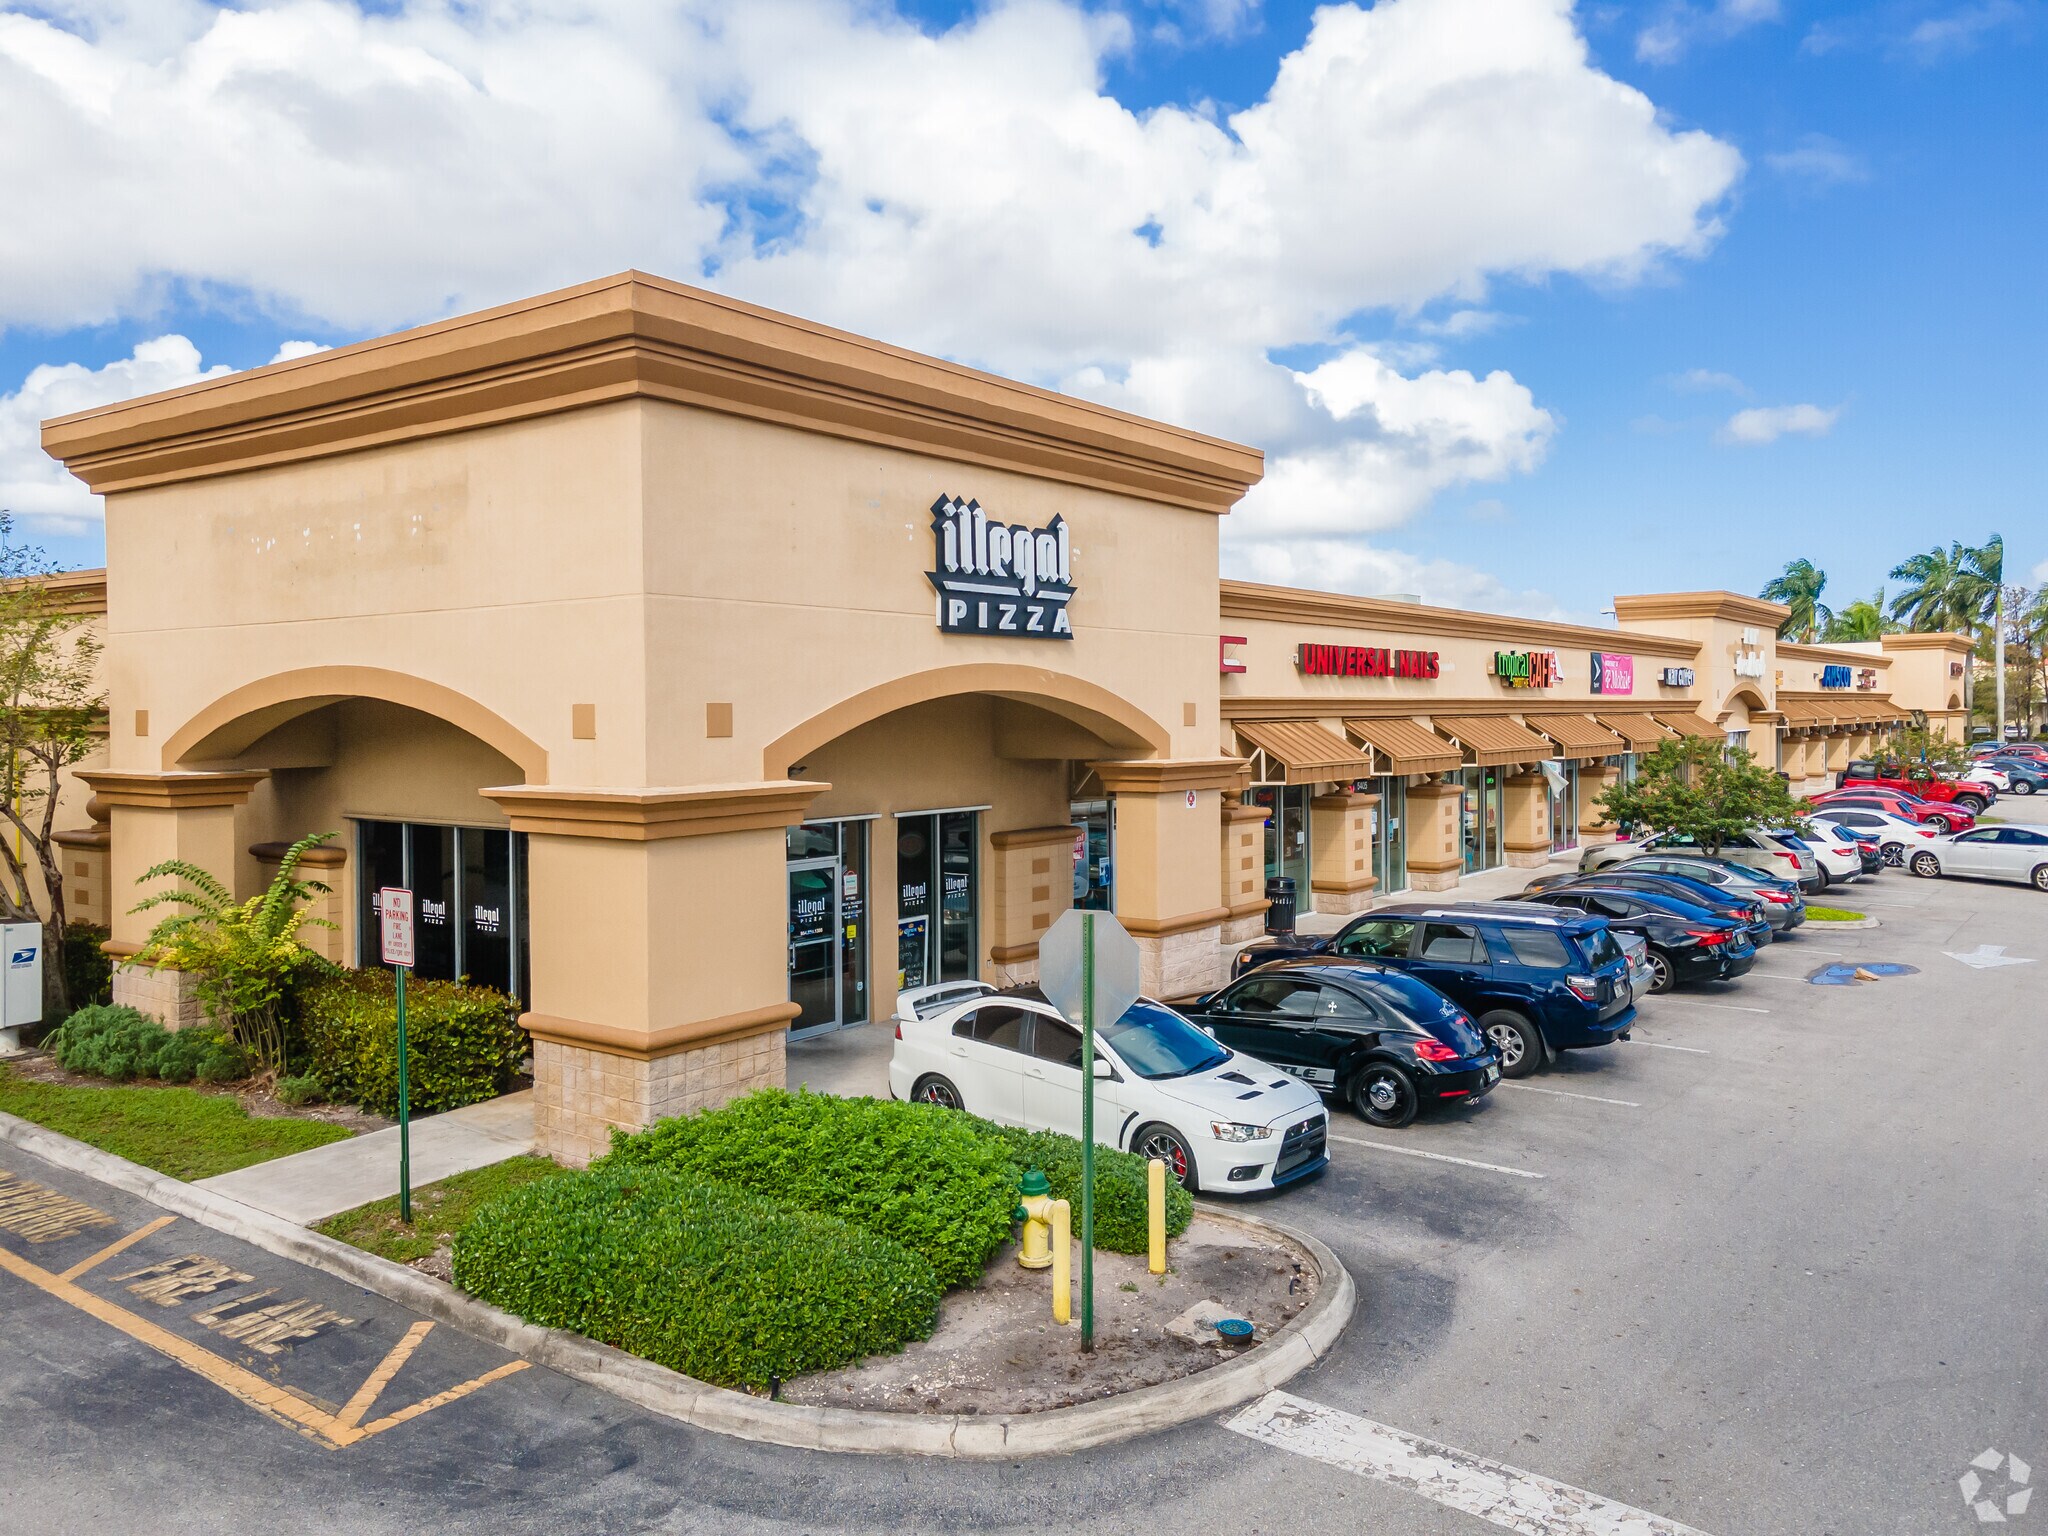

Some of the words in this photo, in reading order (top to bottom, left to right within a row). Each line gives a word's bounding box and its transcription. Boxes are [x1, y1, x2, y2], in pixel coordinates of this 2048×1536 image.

[942, 502, 1071, 597] illegal
[948, 598, 1072, 633] PIZZA
[1301, 643, 1396, 676] UNIVERSAL
[1397, 650, 1440, 679] NAILS
[1496, 650, 1529, 682] tropical
[903, 882, 926, 898] illegal
[946, 875, 968, 892] illegal
[393, 897, 401, 908] NO
[422, 899, 446, 917] illegal
[798, 897, 825, 916] illegal
[385, 909, 409, 922] PARKING
[475, 905, 500, 925] illegal
[800, 915, 823, 924] PIZZA
[392, 932, 403, 941] LANE
[190, 1285, 355, 1355] LANE
